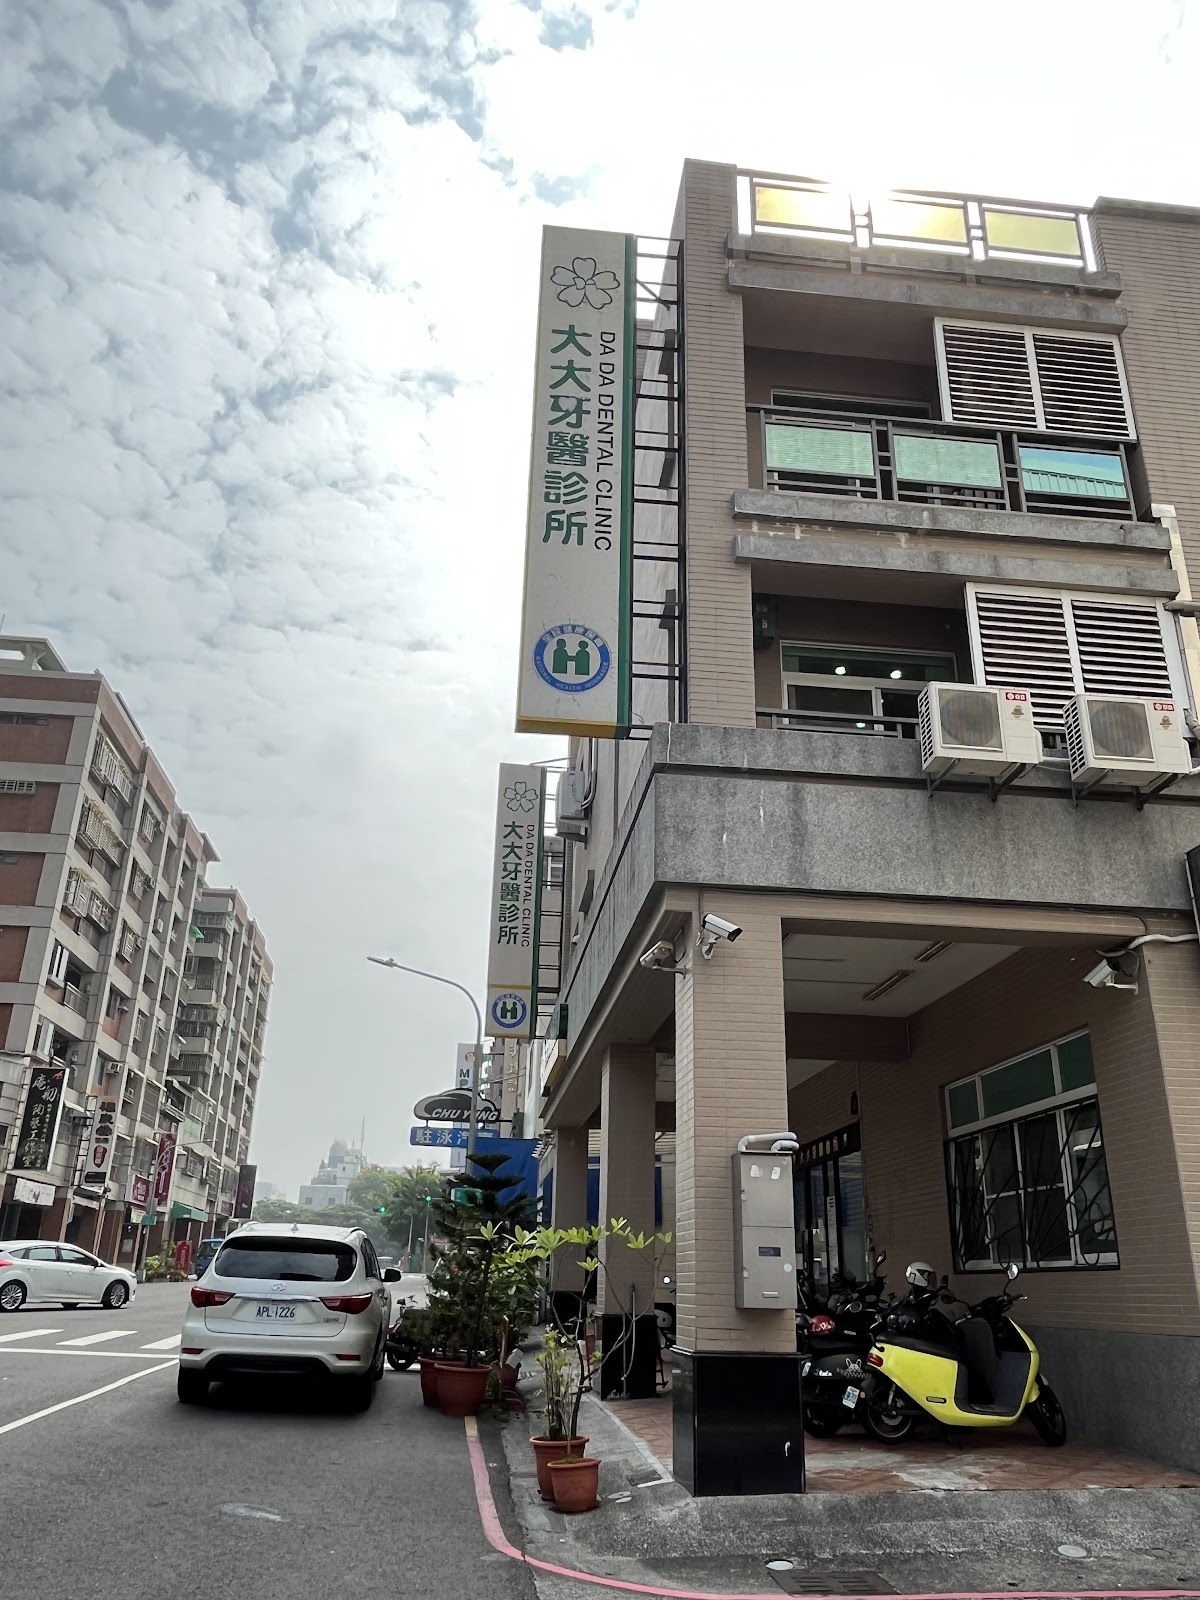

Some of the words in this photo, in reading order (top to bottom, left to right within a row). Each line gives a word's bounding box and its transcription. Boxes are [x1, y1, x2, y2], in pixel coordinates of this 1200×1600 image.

[599, 330, 616, 357] DA
[598, 361, 615, 388] DA
[542, 324, 593, 547] 大大牙醫診所
[596, 394, 615, 473] DENTAL
[594, 479, 614, 552] CLINIC
[525, 841, 536, 857] DA
[526, 824, 536, 840] DA
[498, 820, 525, 946] 大大牙醫診所
[522, 860, 534, 905] DENTAL
[520, 908, 531, 949] CLINIC
[256, 1305, 296, 1318] APL-1226
